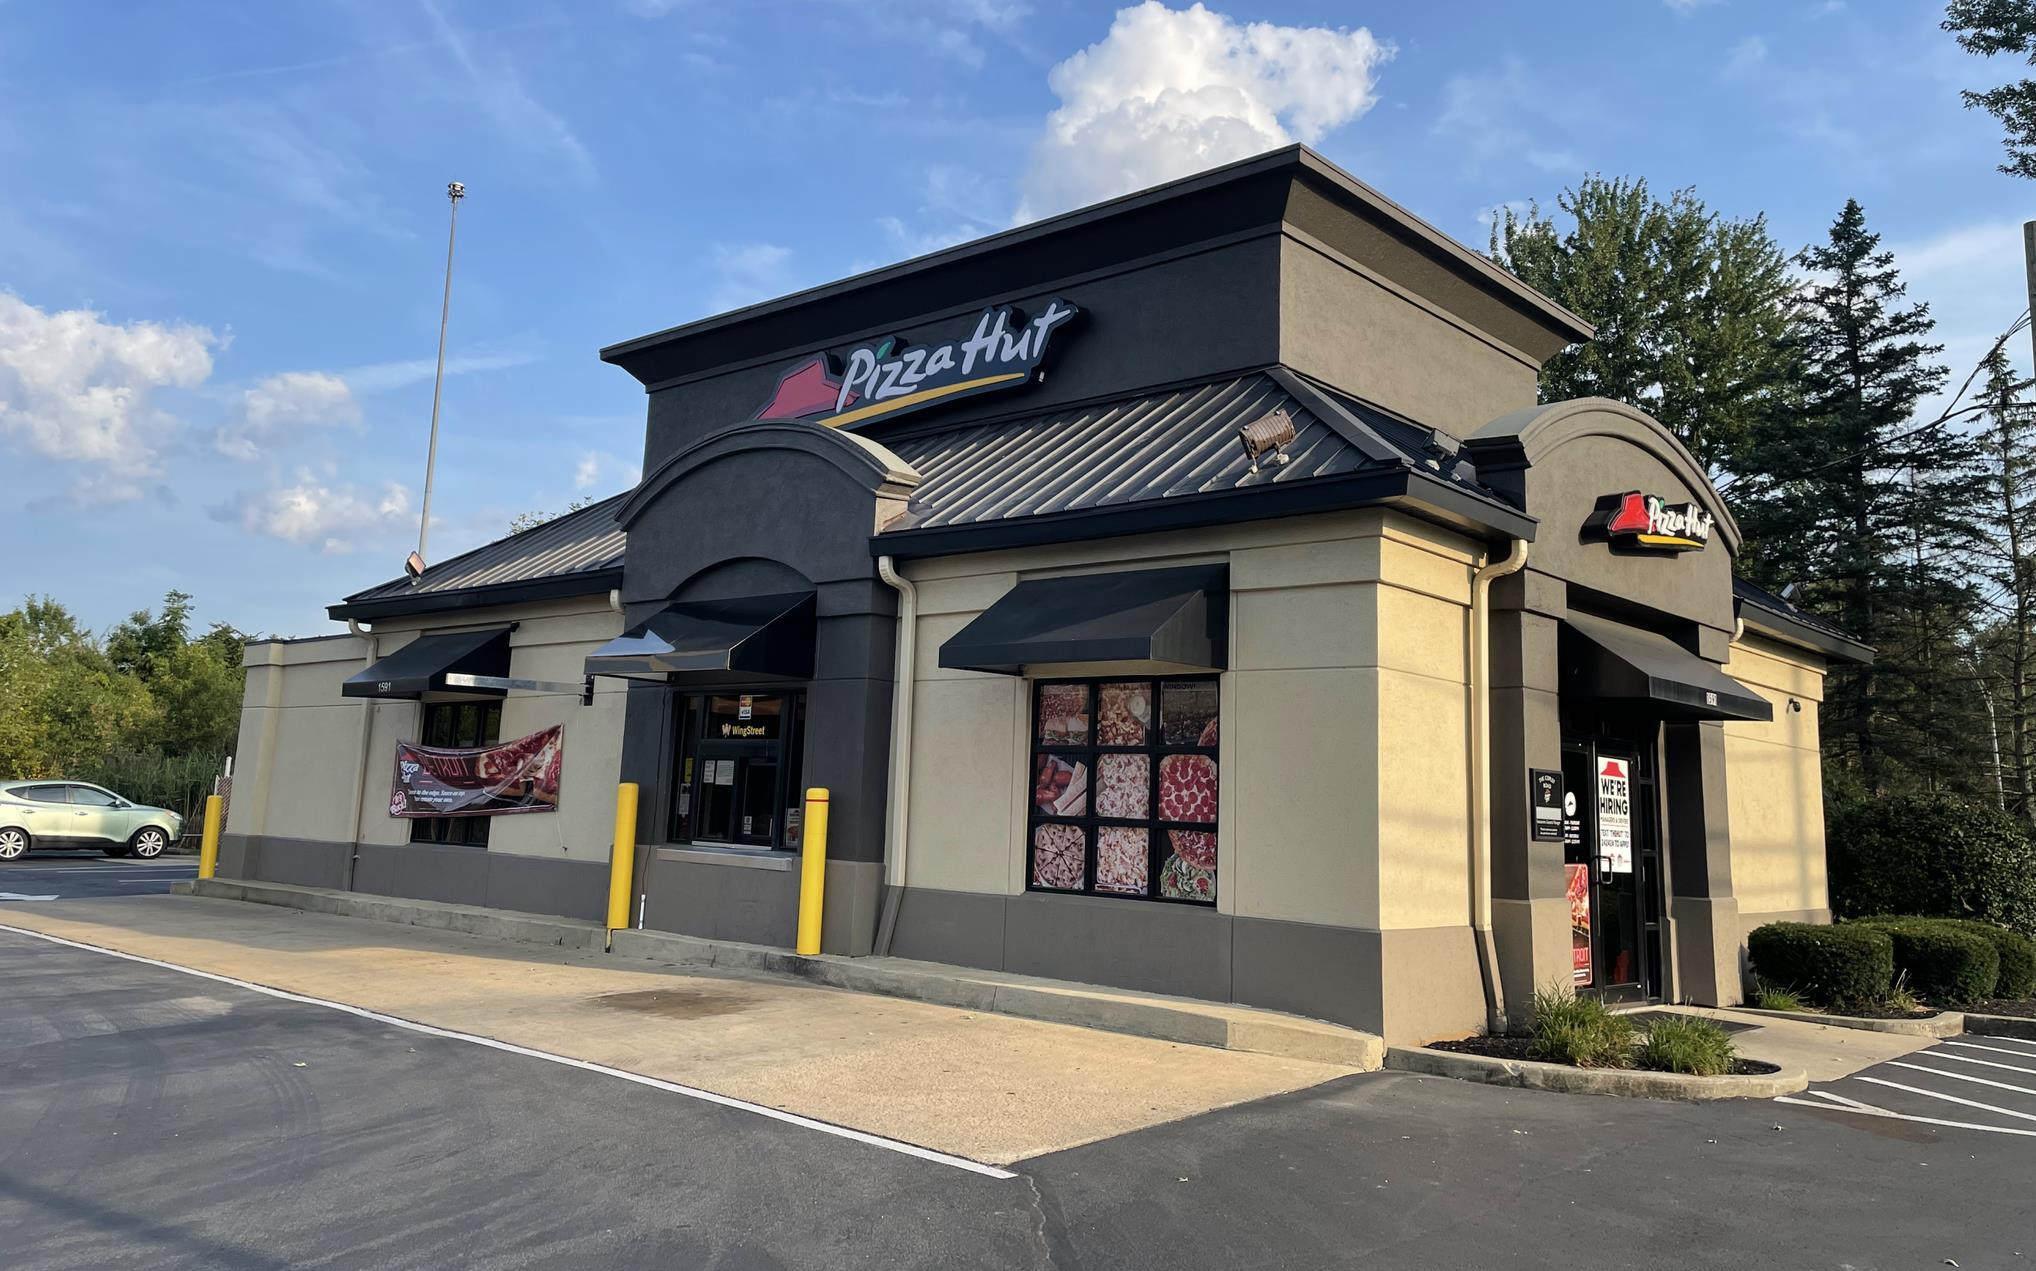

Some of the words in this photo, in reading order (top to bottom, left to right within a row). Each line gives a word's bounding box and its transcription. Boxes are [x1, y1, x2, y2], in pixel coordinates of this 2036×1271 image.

[835, 343, 956, 414] Pizza
[960, 302, 1071, 375] Hut
[1647, 497, 1686, 536] Pizza
[1684, 503, 1715, 540] Hut
[378, 681, 392, 692] 1591
[732, 725, 765, 737] WingStreet
[1601, 779, 1626, 797] WE'RE
[1600, 797, 1629, 816] HIRING
